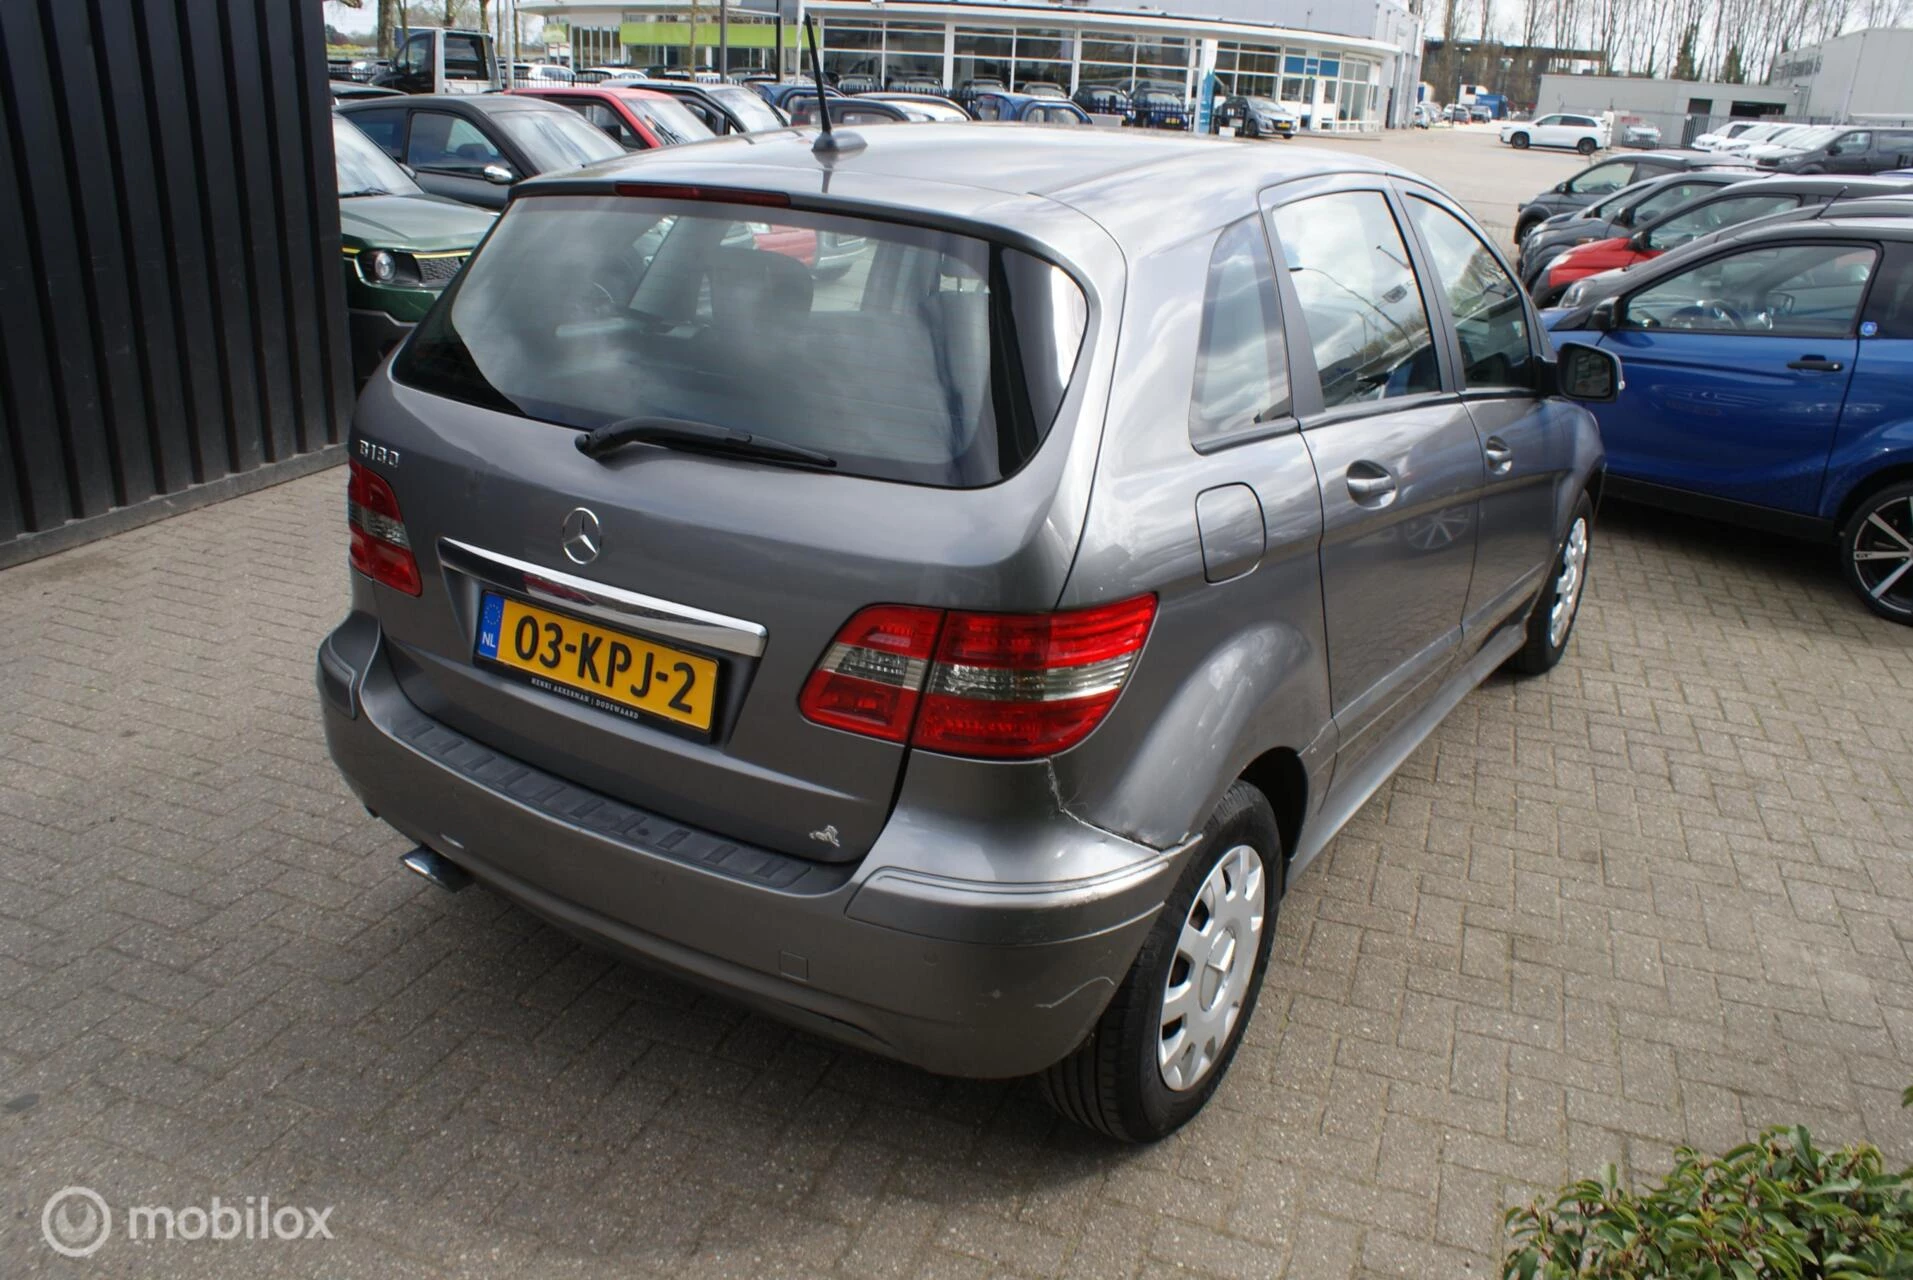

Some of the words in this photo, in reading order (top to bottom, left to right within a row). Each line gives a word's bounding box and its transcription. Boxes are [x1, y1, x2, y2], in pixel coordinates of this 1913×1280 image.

[482, 631, 496, 648] NL
[515, 615, 696, 714] 03-KPJ-2
[531, 677, 552, 690] HENRI
[553, 685, 590, 703] AKKERMAN
[596, 699, 639, 720] DODEWAARD
